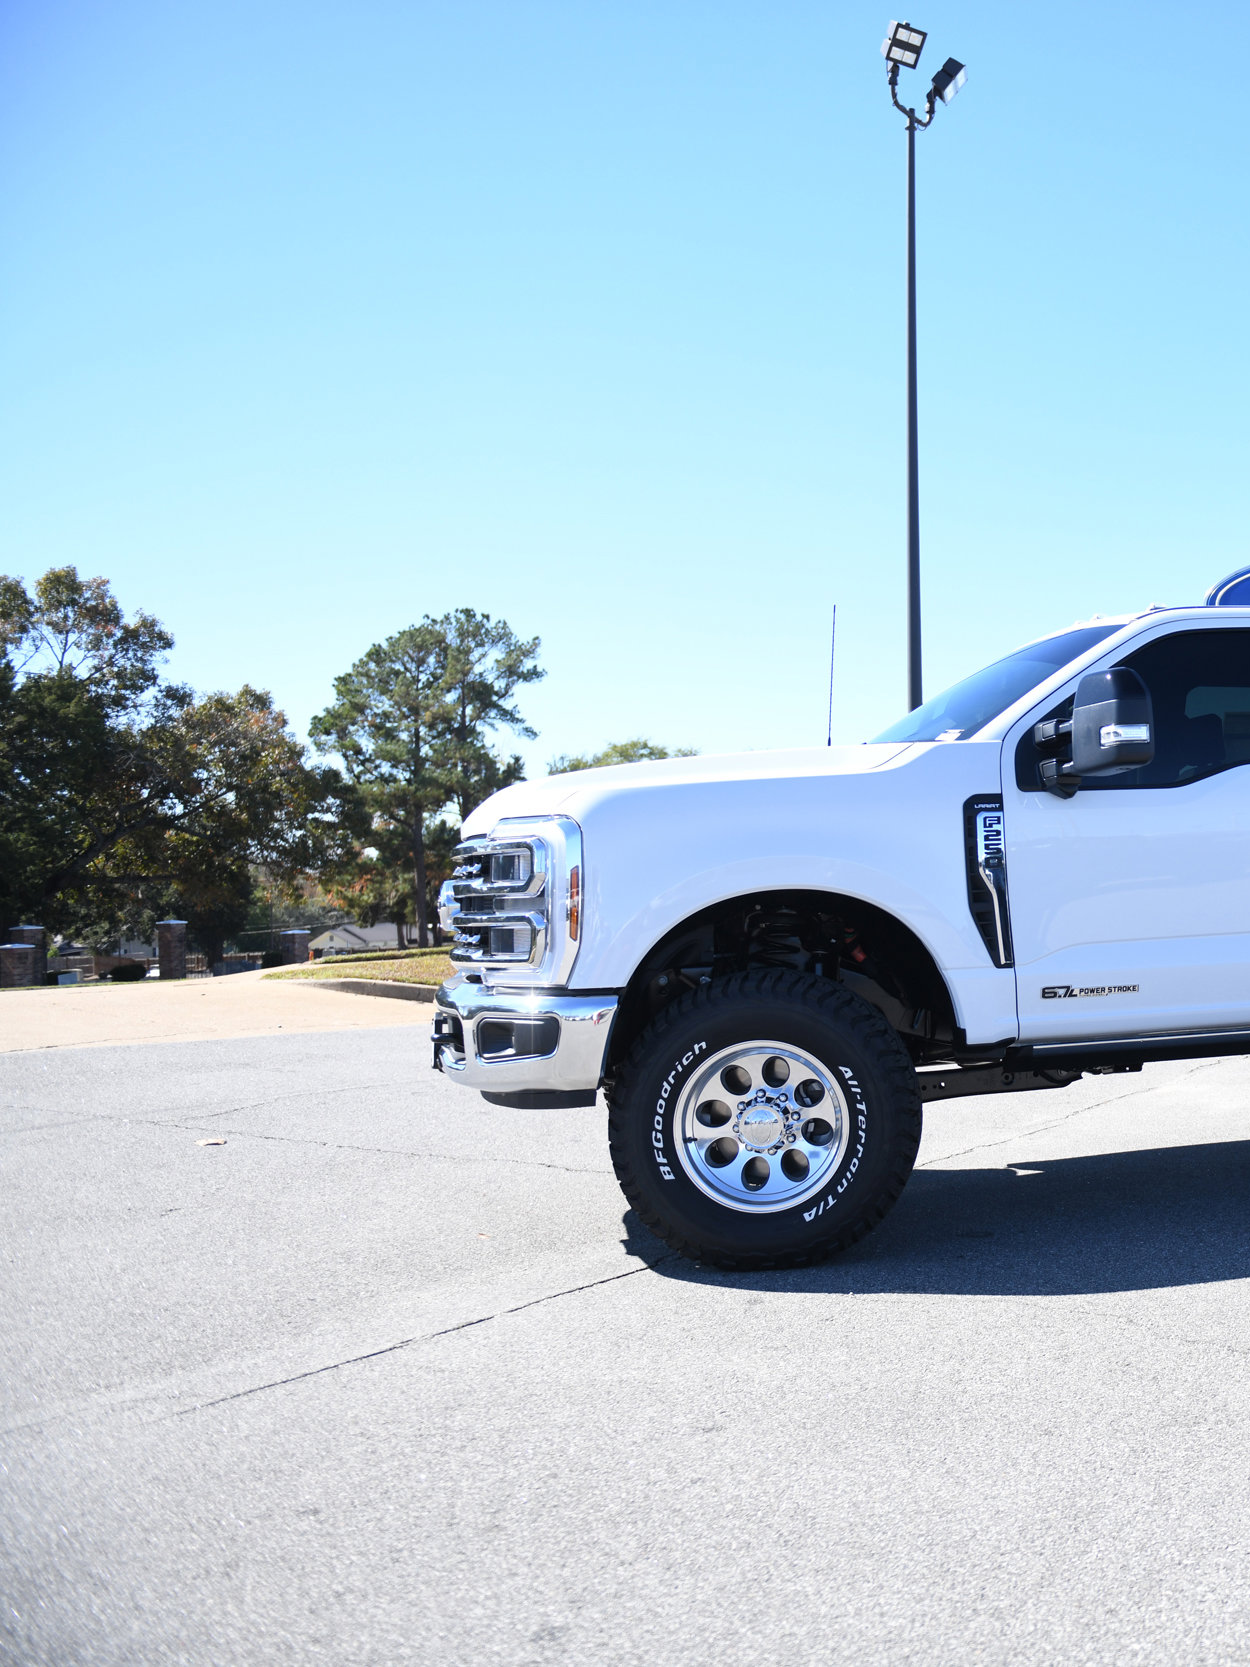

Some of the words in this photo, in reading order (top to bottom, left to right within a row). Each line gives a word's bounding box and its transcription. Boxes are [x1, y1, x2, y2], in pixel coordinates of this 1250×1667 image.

[1042, 985, 1078, 999] 6.7L
[1079, 987, 1106, 995] POWER
[1107, 984, 1138, 993] STROKE
[651, 1040, 707, 1181] BFGoodrich
[836, 1064, 868, 1194] All-Terrain
[802, 1196, 837, 1223] T/A
